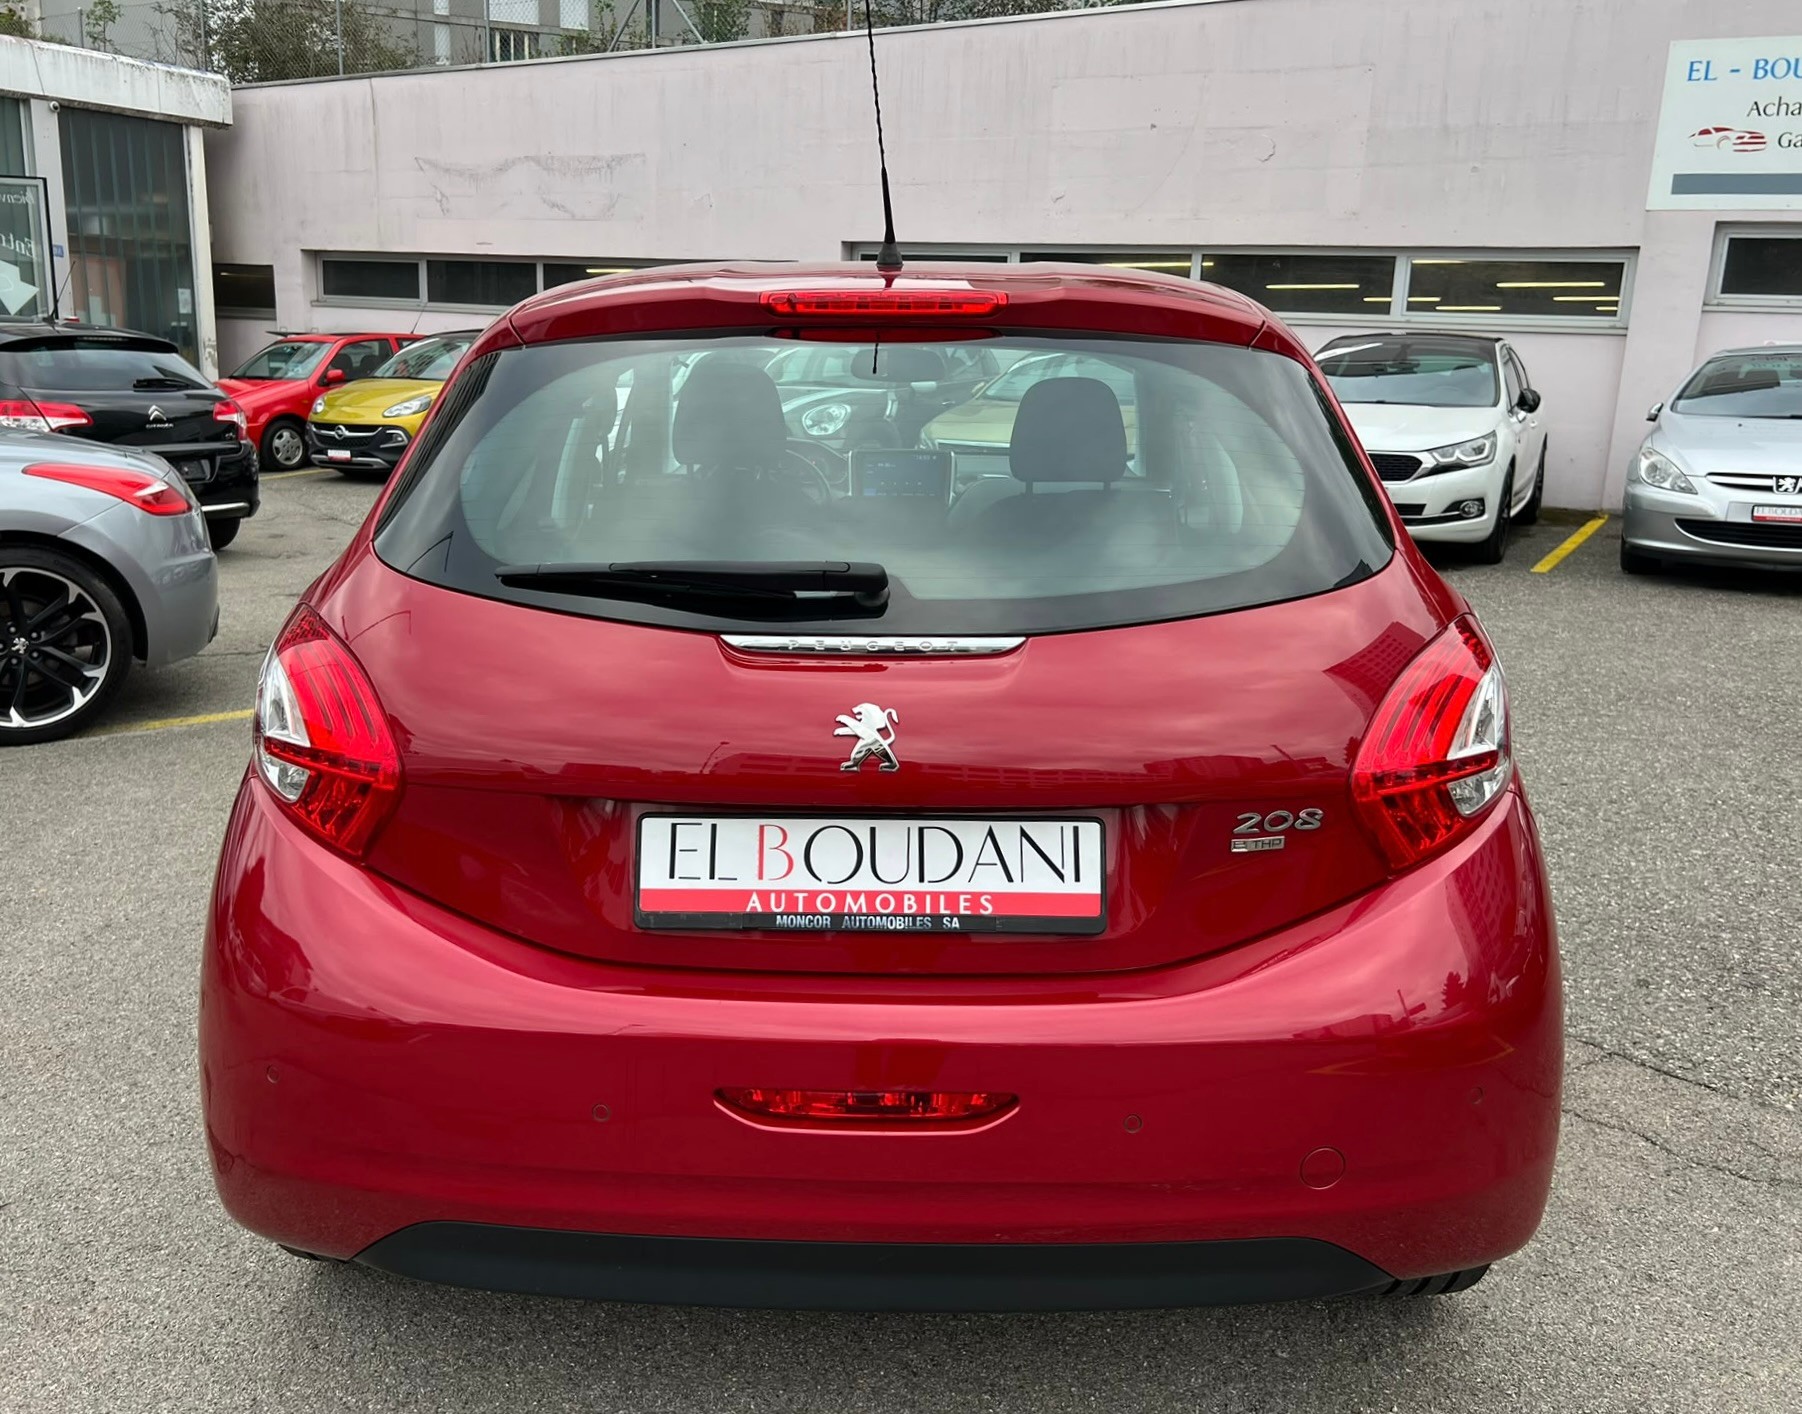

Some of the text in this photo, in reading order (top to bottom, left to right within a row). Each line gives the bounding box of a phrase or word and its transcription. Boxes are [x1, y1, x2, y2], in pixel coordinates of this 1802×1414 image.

[1687, 60, 1717, 81] EL
[787, 639, 958, 651] PEUGEOT
[1233, 808, 1324, 834] 208
[669, 822, 1081, 885] EL BOUDANI
[1253, 838, 1282, 849] THP
[746, 891, 993, 915] AUTOMOBILES
[776, 914, 960, 930] MONCOR AUTOMOBILES SA
